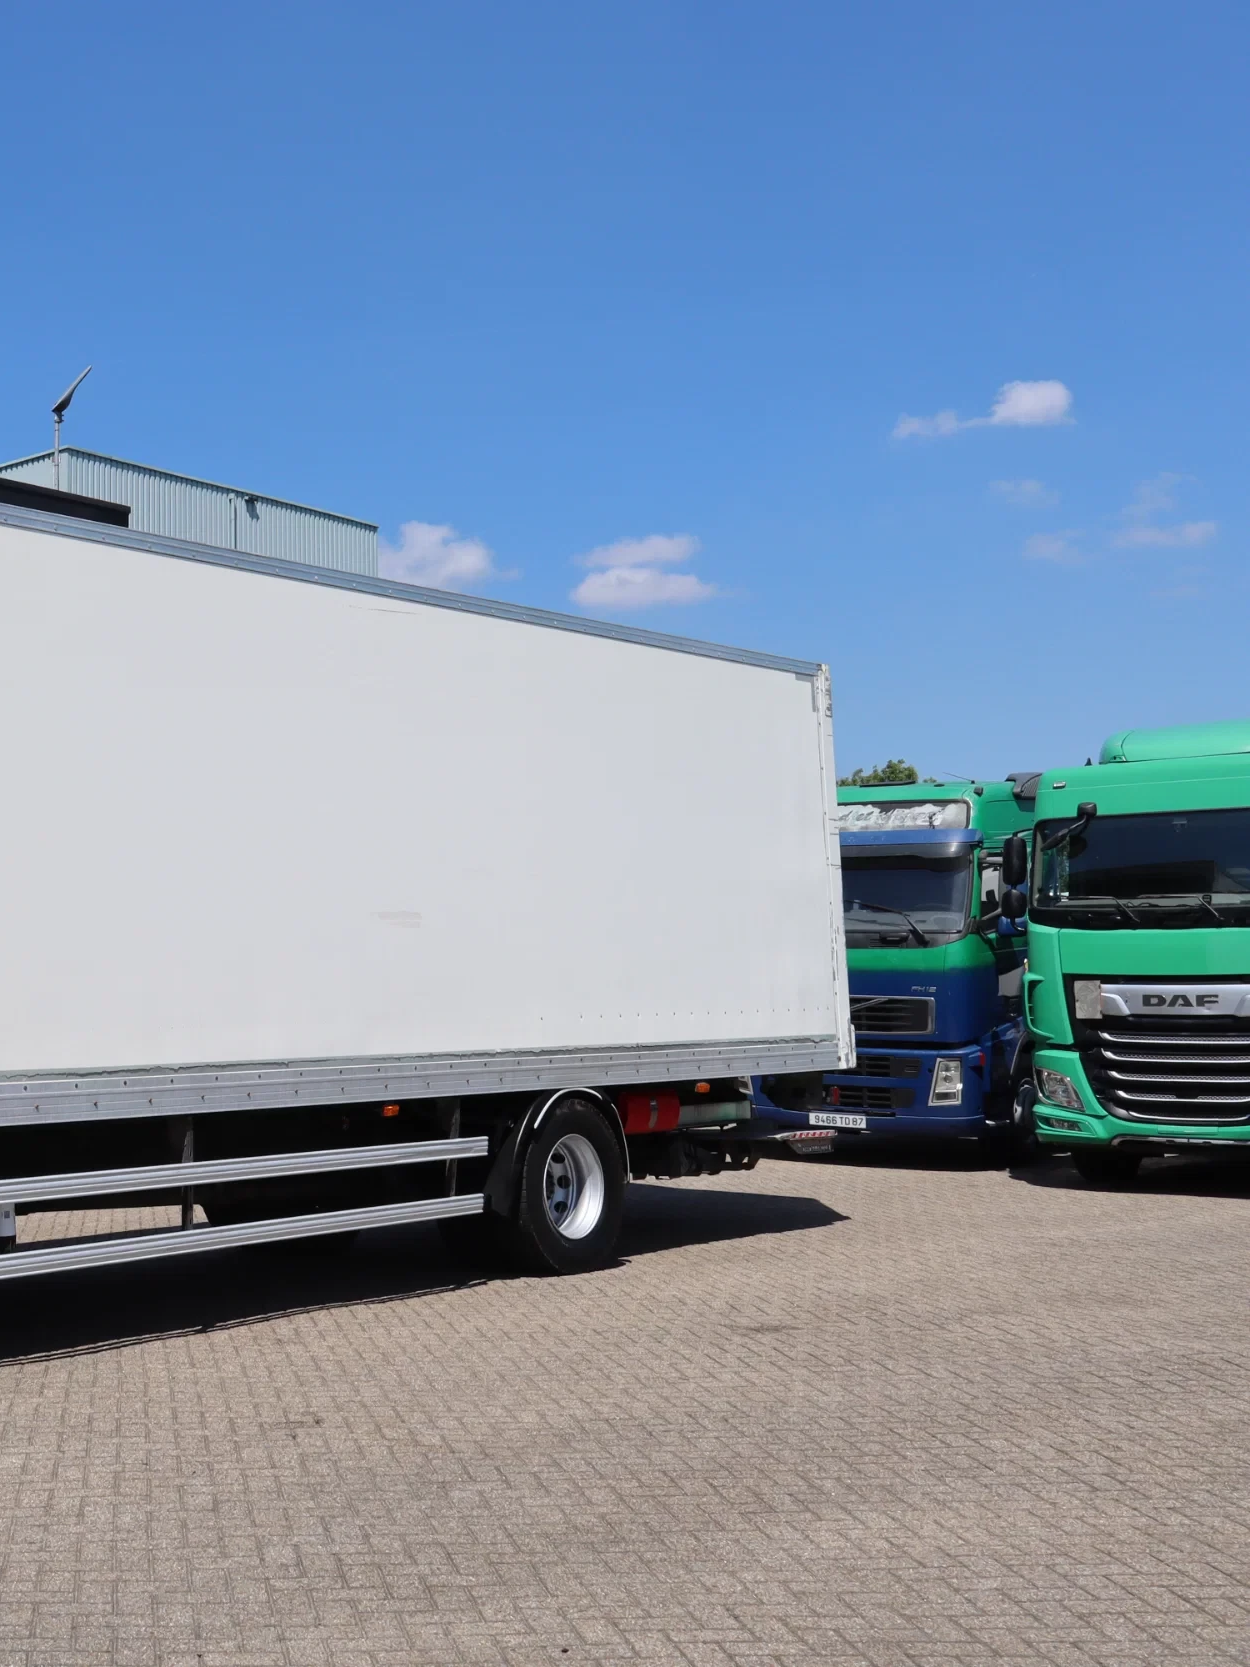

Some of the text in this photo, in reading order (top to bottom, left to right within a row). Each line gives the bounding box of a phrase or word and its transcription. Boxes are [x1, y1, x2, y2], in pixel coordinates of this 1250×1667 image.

[1142, 994, 1219, 1007] DAF
[814, 1114, 864, 1126] 9466 TD 87
